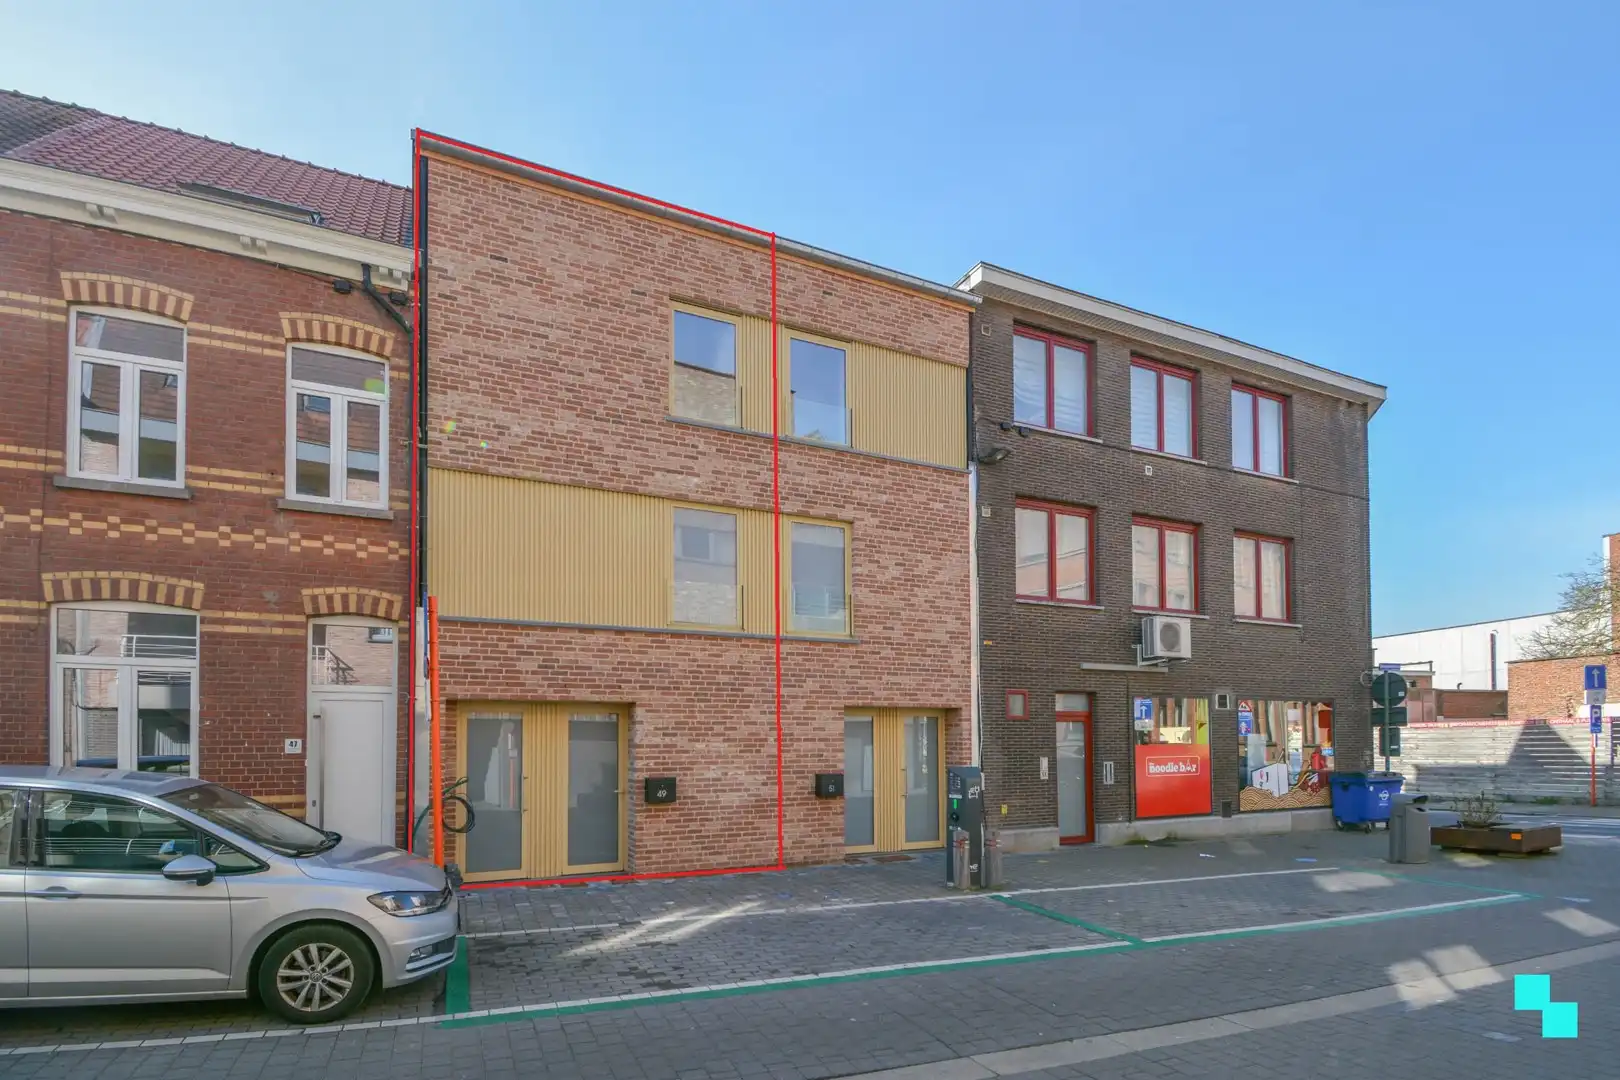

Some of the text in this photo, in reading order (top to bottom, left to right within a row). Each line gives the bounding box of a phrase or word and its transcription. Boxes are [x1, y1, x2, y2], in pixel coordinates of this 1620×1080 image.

[1592, 709, 1600, 723] P
[1149, 759, 1197, 773] noodle bar
[656, 790, 667, 798] 49
